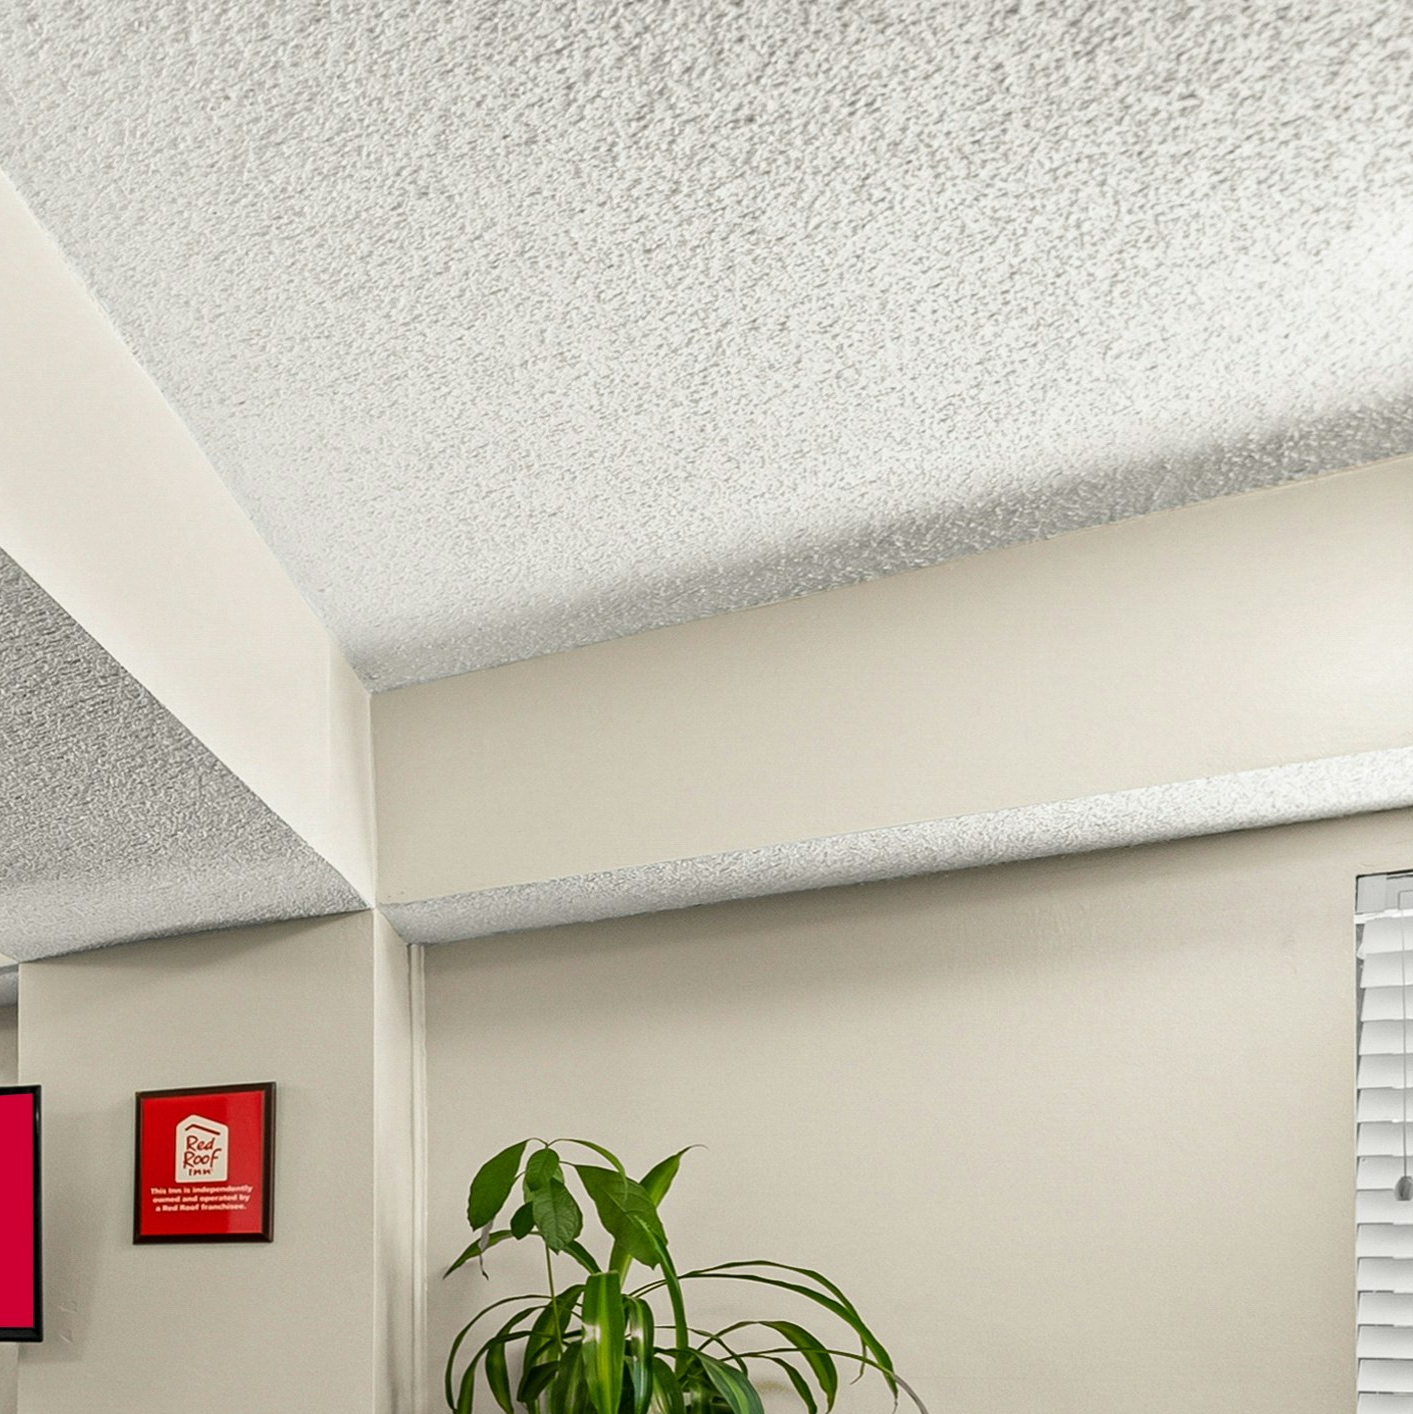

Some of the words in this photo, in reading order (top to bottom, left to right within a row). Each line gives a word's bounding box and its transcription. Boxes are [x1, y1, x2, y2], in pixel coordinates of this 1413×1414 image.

[185, 1135, 215, 1151] Red
[183, 1148, 222, 1169] Roof
[192, 1184, 253, 1193] independently
[199, 1194, 237, 1202] operated
[238, 1194, 251, 1202] by
[179, 1203, 199, 1211] Roof
